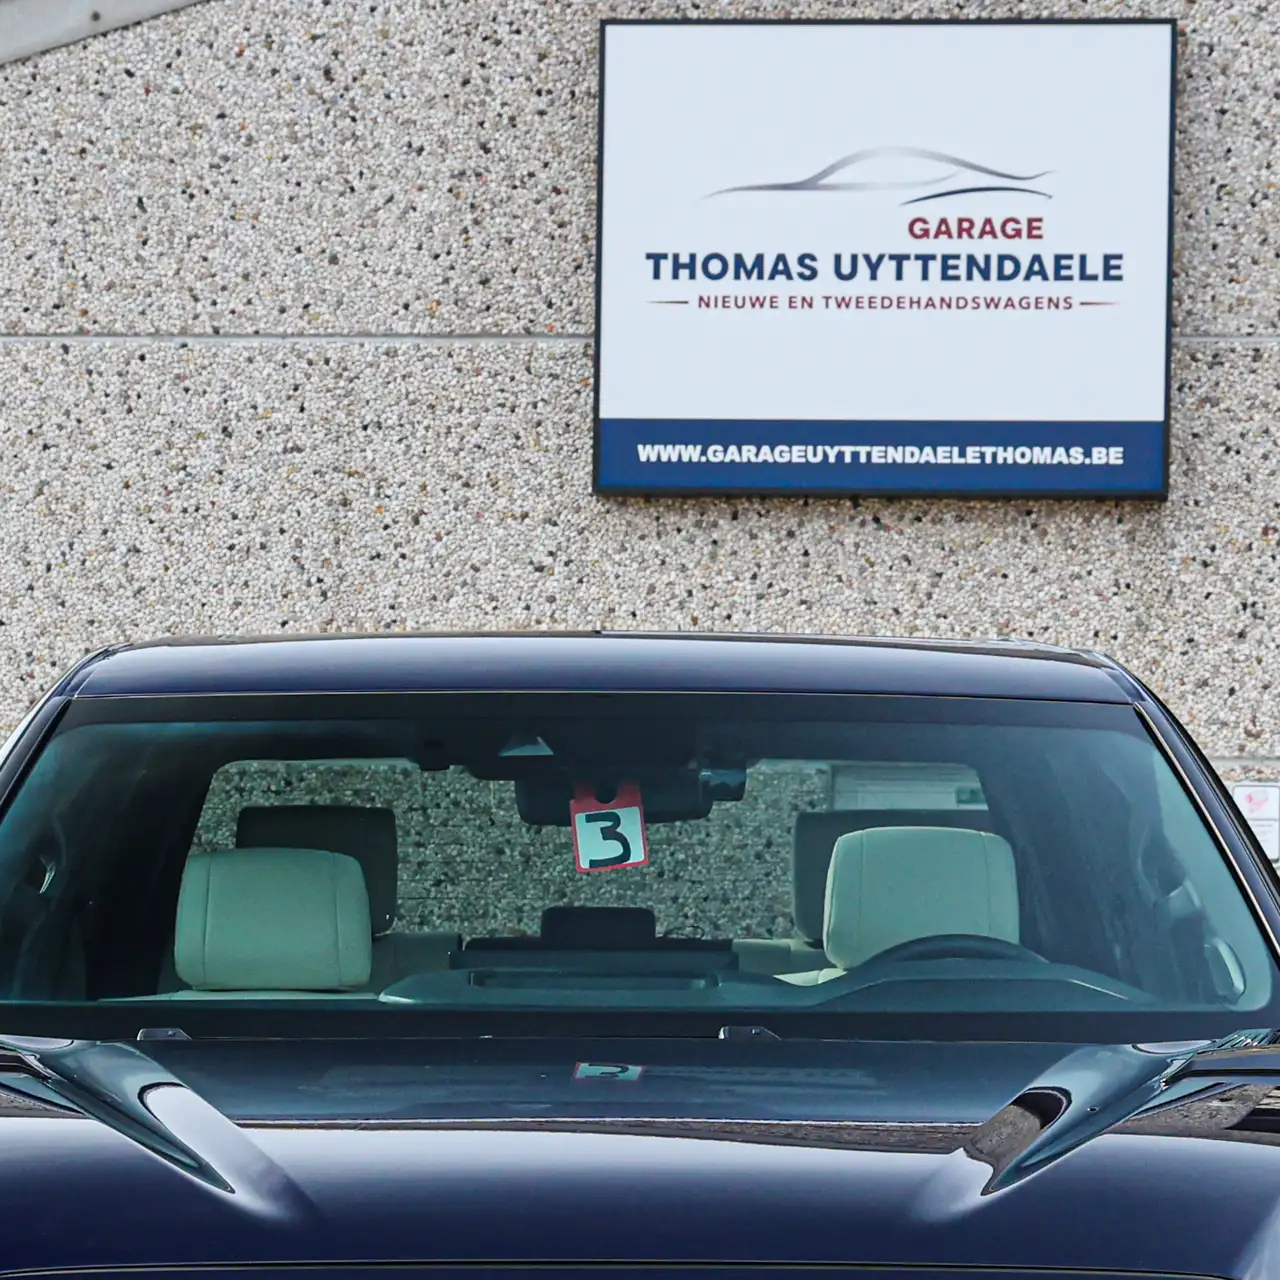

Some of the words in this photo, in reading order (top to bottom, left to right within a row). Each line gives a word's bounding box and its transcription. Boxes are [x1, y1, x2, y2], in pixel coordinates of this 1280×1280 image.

[908, 217, 1044, 240] GARAGE
[645, 252, 819, 281] THOMAS
[833, 252, 1124, 282] UYTTENDAELE
[697, 295, 780, 309] NIEUWE
[788, 295, 814, 309] EN
[822, 295, 1073, 310] TWEEDEHANDSWAGENS
[637, 443, 1124, 465] WWW.GARAGEUYTTENDAELETHOMAS.BE
[584, 811, 632, 869] 3
